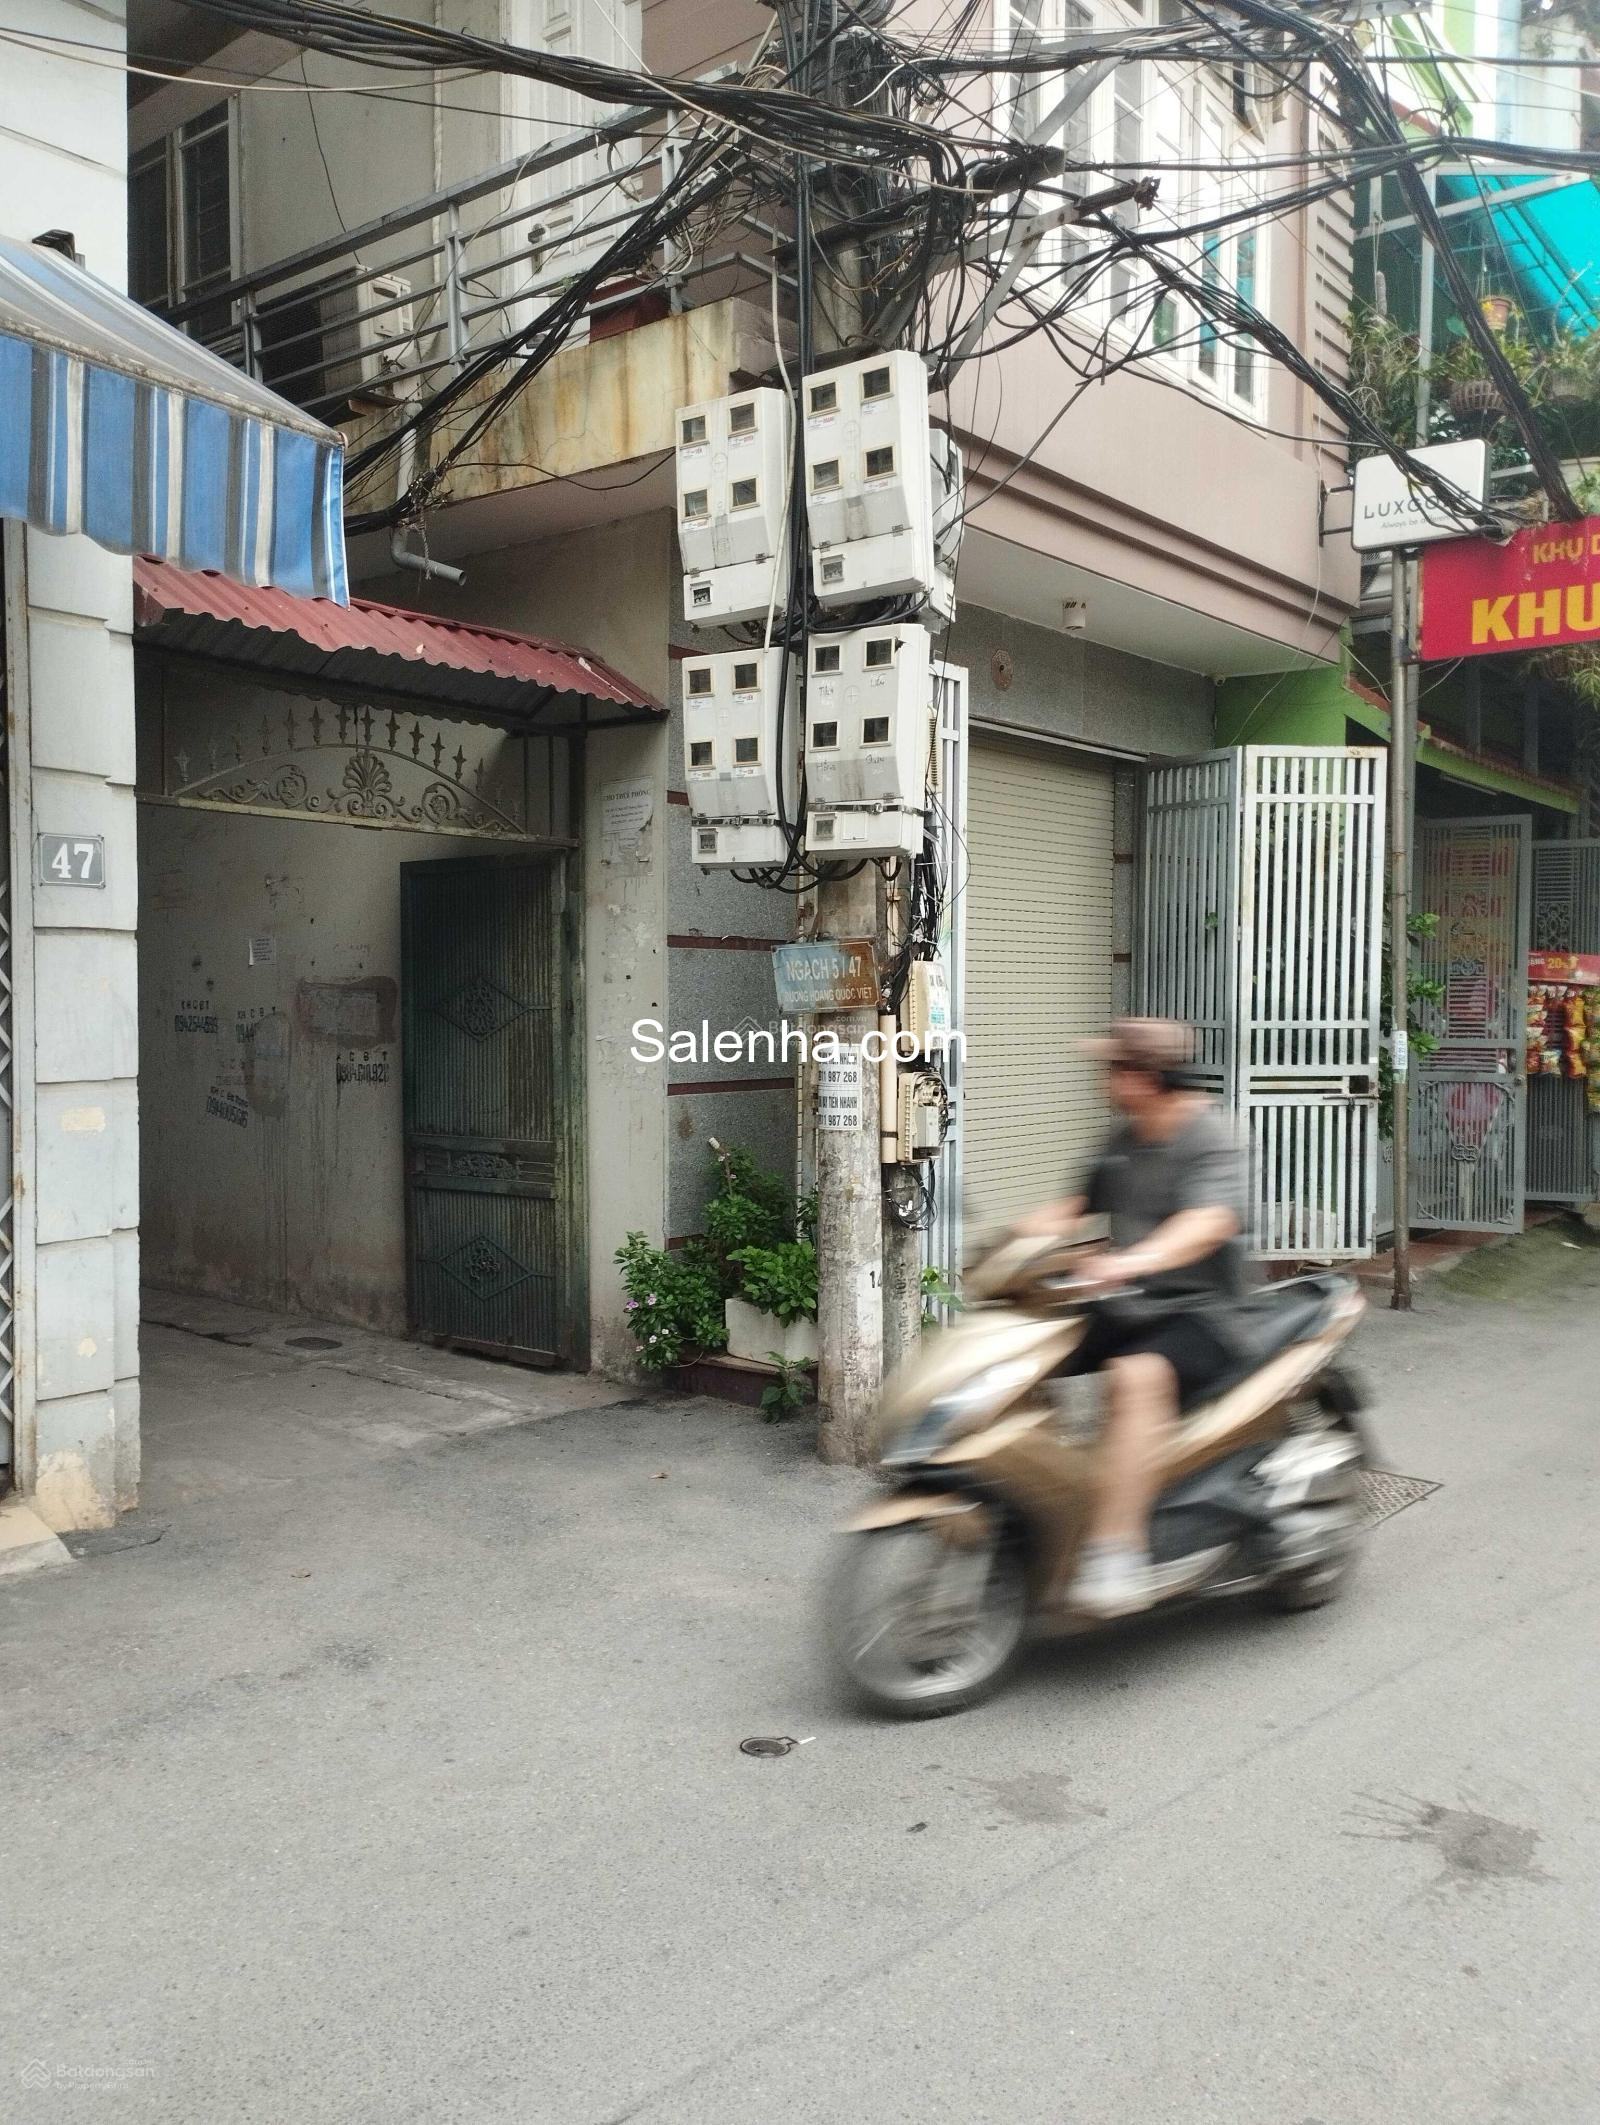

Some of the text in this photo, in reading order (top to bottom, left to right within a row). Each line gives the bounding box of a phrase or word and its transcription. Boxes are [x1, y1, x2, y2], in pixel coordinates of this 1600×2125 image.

[51, 843, 95, 879] 47
[848, 956, 861, 978] 47
[828, 1071, 840, 1083] 987
[843, 1071, 858, 1083] 268
[828, 1115, 840, 1127] 987
[843, 1115, 858, 1127] 268
